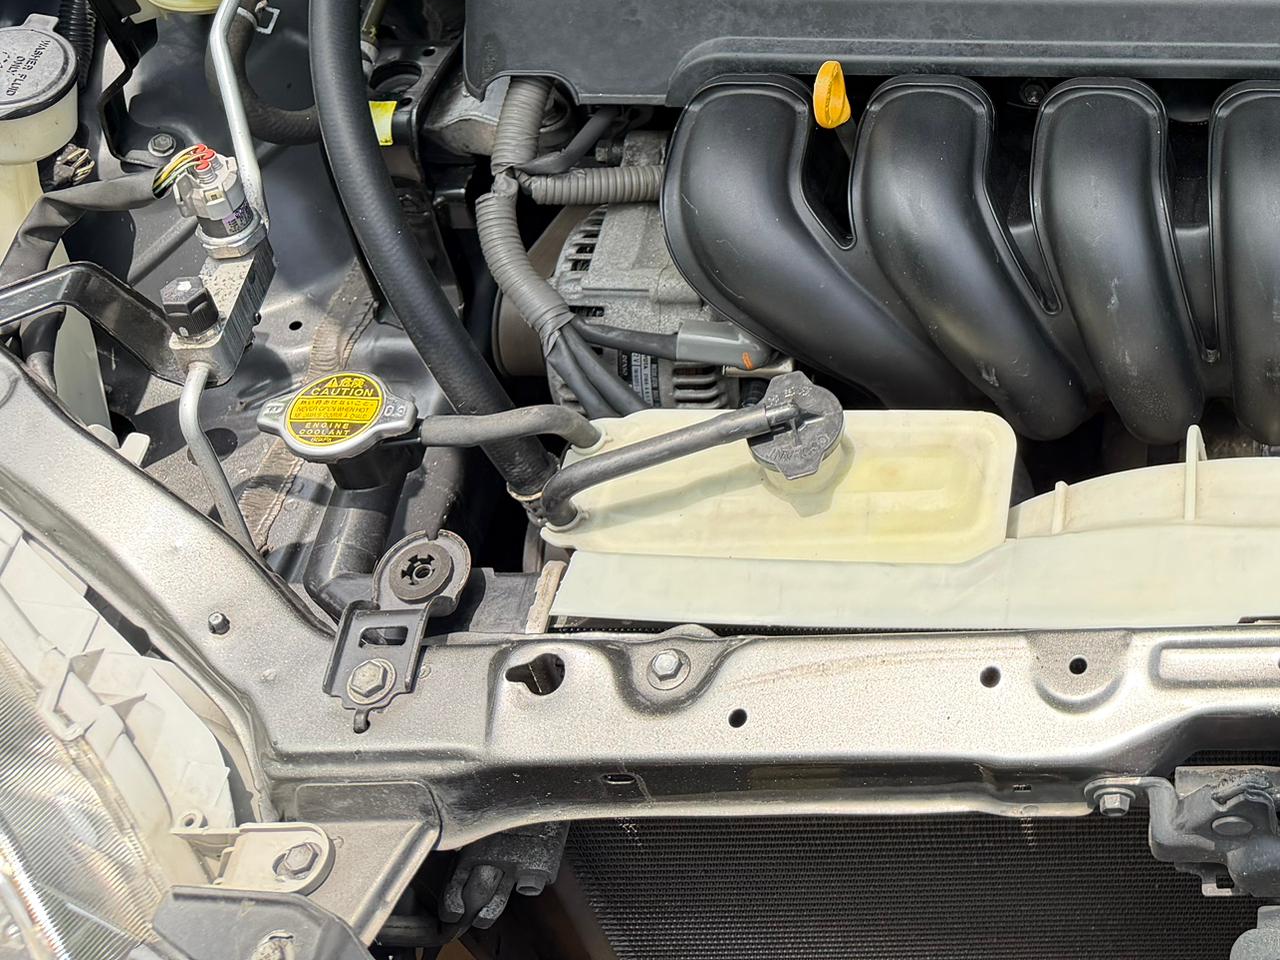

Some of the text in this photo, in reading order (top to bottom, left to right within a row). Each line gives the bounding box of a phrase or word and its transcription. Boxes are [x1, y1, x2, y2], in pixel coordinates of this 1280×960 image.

[6, 40, 51, 96] WASHER FLUID
[7, 56, 25, 75] ONLY
[310, 388, 375, 397] CAUTION
